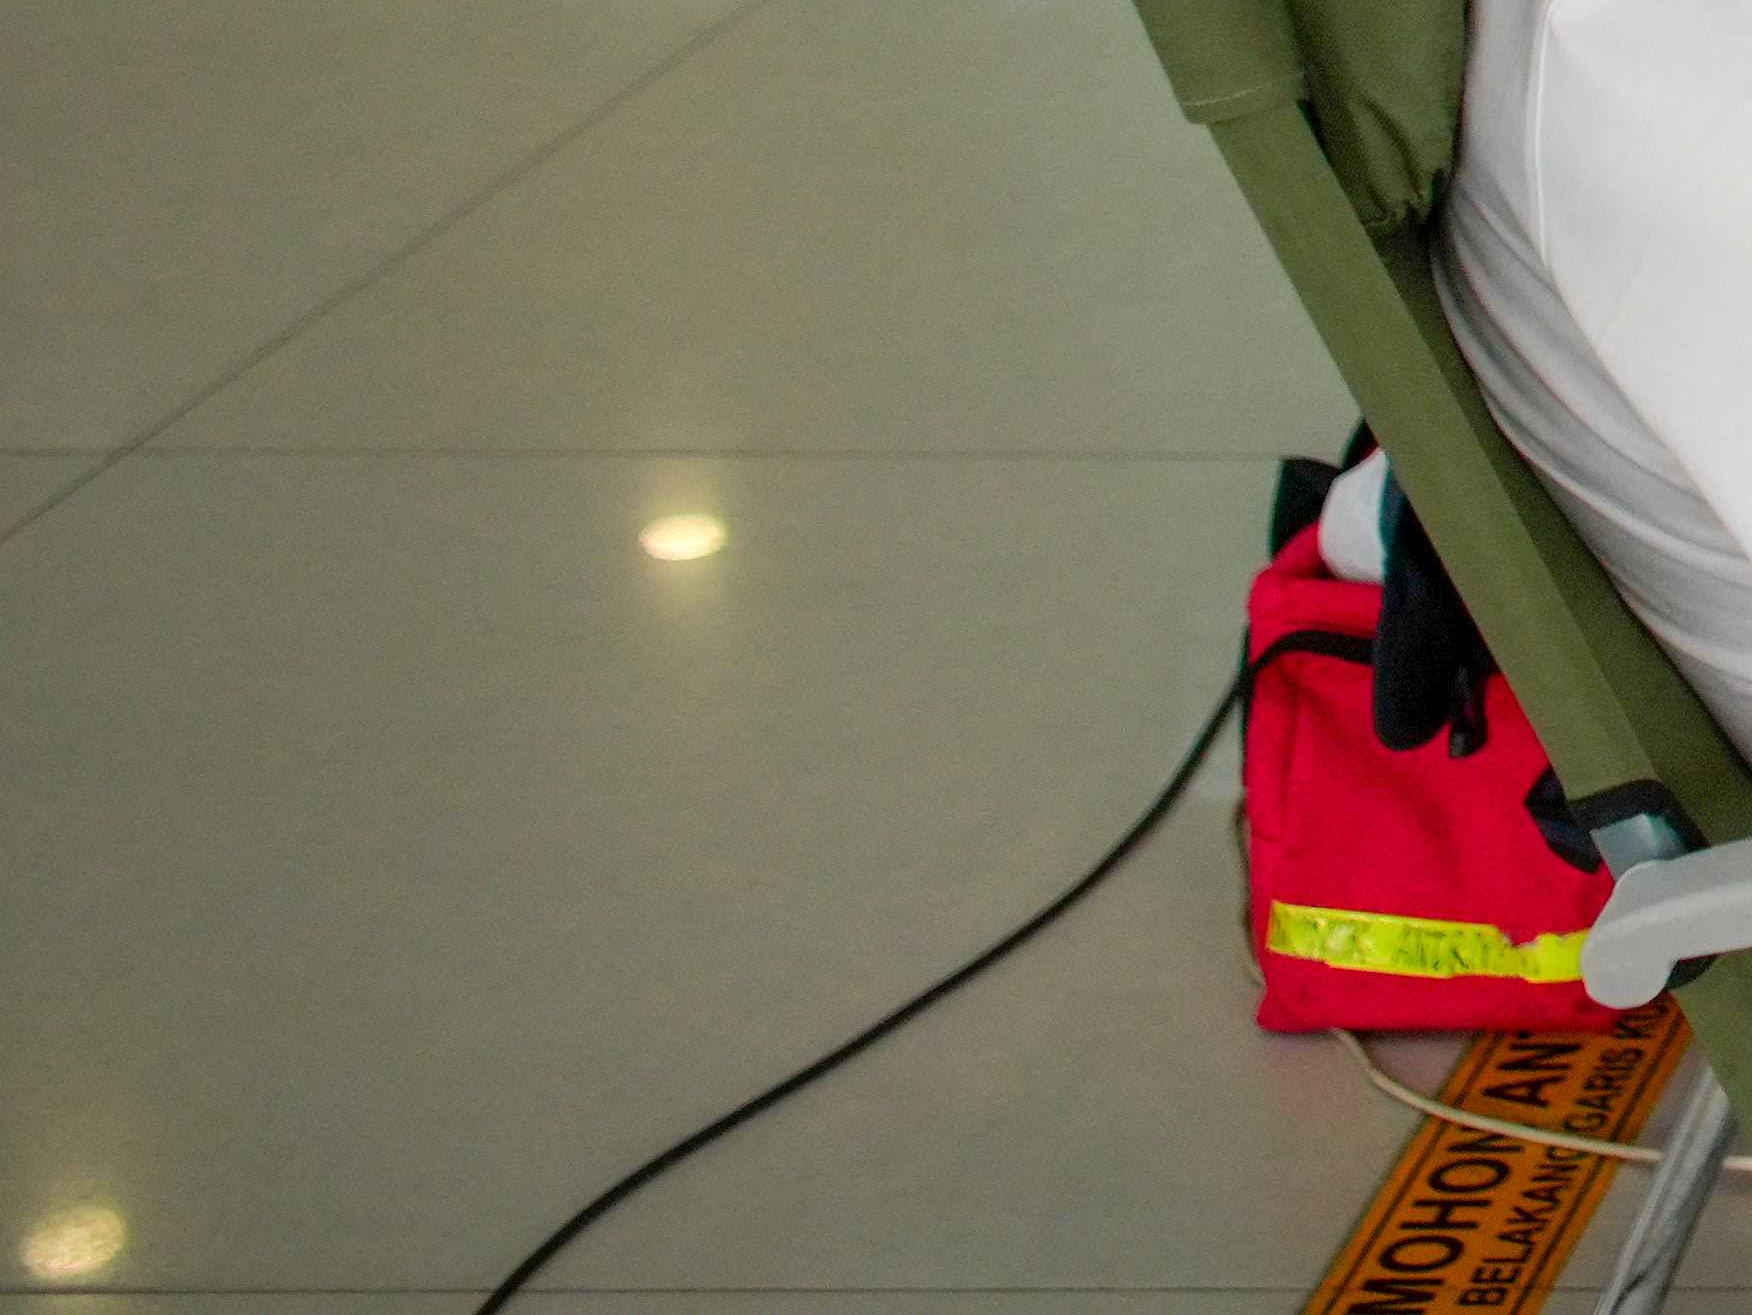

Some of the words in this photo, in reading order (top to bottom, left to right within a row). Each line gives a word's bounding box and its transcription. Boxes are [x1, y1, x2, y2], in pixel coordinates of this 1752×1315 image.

[1343, 1123, 1528, 1315] MOHON
[1481, 1029, 1582, 1108] AN
[1456, 1144, 1590, 1308] BELAKANG
[1562, 1046, 1645, 1135] GARIS
